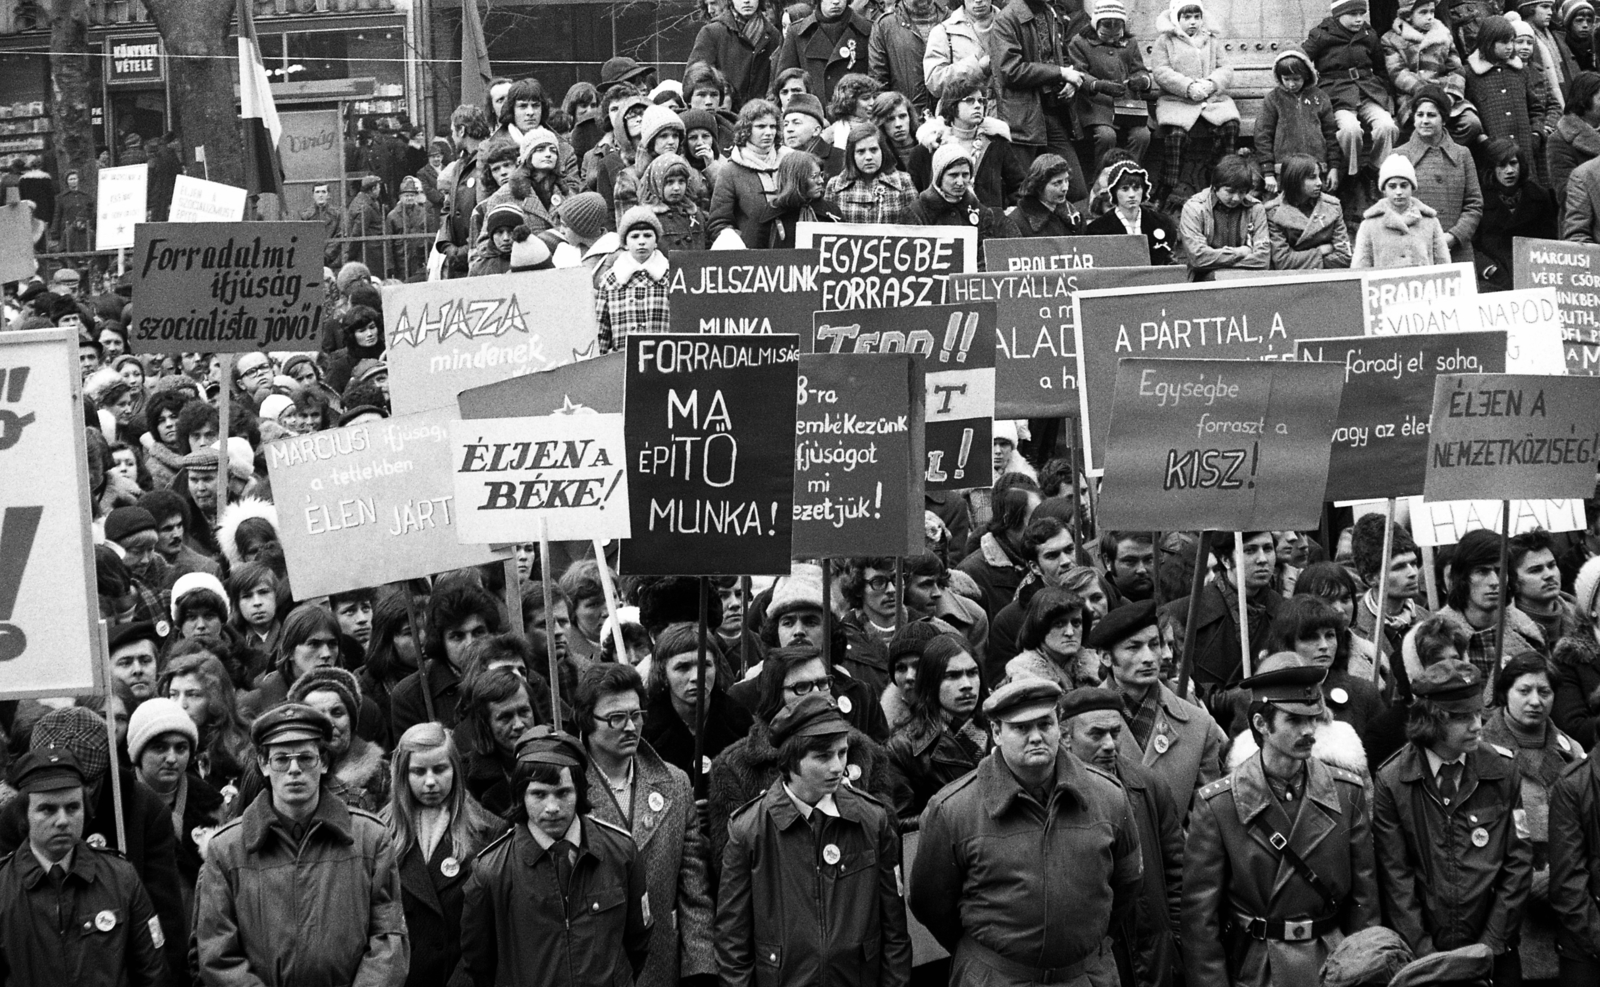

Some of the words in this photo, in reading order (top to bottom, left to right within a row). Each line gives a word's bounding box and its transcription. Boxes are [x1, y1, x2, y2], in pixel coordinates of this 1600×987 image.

[115, 59, 154, 73] VÉTELE
[142, 236, 298, 278] Forradalmi
[819, 236, 954, 275] EGYSÉGBE
[1008, 246, 1094, 271] PROLETÁR
[1529, 247, 1591, 269] MÁRCIUSI
[669, 267, 688, 294] A
[691, 264, 820, 295] JELSZAVUNK
[823, 275, 950, 311] FORRASZT
[955, 272, 1079, 300] HELYTÁLLÁS
[1532, 267, 1563, 285] VÉRE
[137, 305, 258, 341] szocialista
[257, 302, 322, 348] jövő!
[700, 317, 773, 335] MUNKA
[1039, 306, 1052, 319] a
[1387, 299, 1460, 335] VIDÁM
[1479, 298, 1553, 327] NAPOD
[1559, 309, 1600, 328] SUTH,
[1115, 324, 1132, 353] A
[1140, 308, 1263, 351] PÁRTTAL,
[1269, 312, 1288, 340] A
[430, 333, 547, 374] mindenek
[638, 339, 799, 373] FORRADALMISÁG
[1345, 349, 1402, 384] fáradj
[1407, 351, 1424, 372] el
[1436, 349, 1483, 374] soha,
[1566, 347, 1579, 361] A
[1039, 376, 1052, 389] a
[1139, 369, 1239, 407] Egységbe
[668, 388, 732, 430] MA
[1530, 389, 1546, 417] A
[1197, 412, 1265, 438] forraszt
[1275, 422, 1288, 435] a
[1375, 423, 1395, 438] az
[269, 427, 371, 469] MÁRCIUSI
[457, 436, 595, 473] ÉLJEN
[588, 448, 613, 468] A
[795, 439, 878, 471] fjúságot
[1433, 424, 1599, 469] NEMZETKÖZISÉG!
[311, 478, 323, 491] a
[330, 459, 414, 486] tettekben
[808, 472, 830, 493] mi
[1163, 440, 1259, 491] KISZ!
[477, 469, 624, 511] BÉKE!
[793, 481, 882, 528] ezetjük!
[304, 494, 378, 535] ÉLEN
[649, 498, 778, 536] MUNKA!
